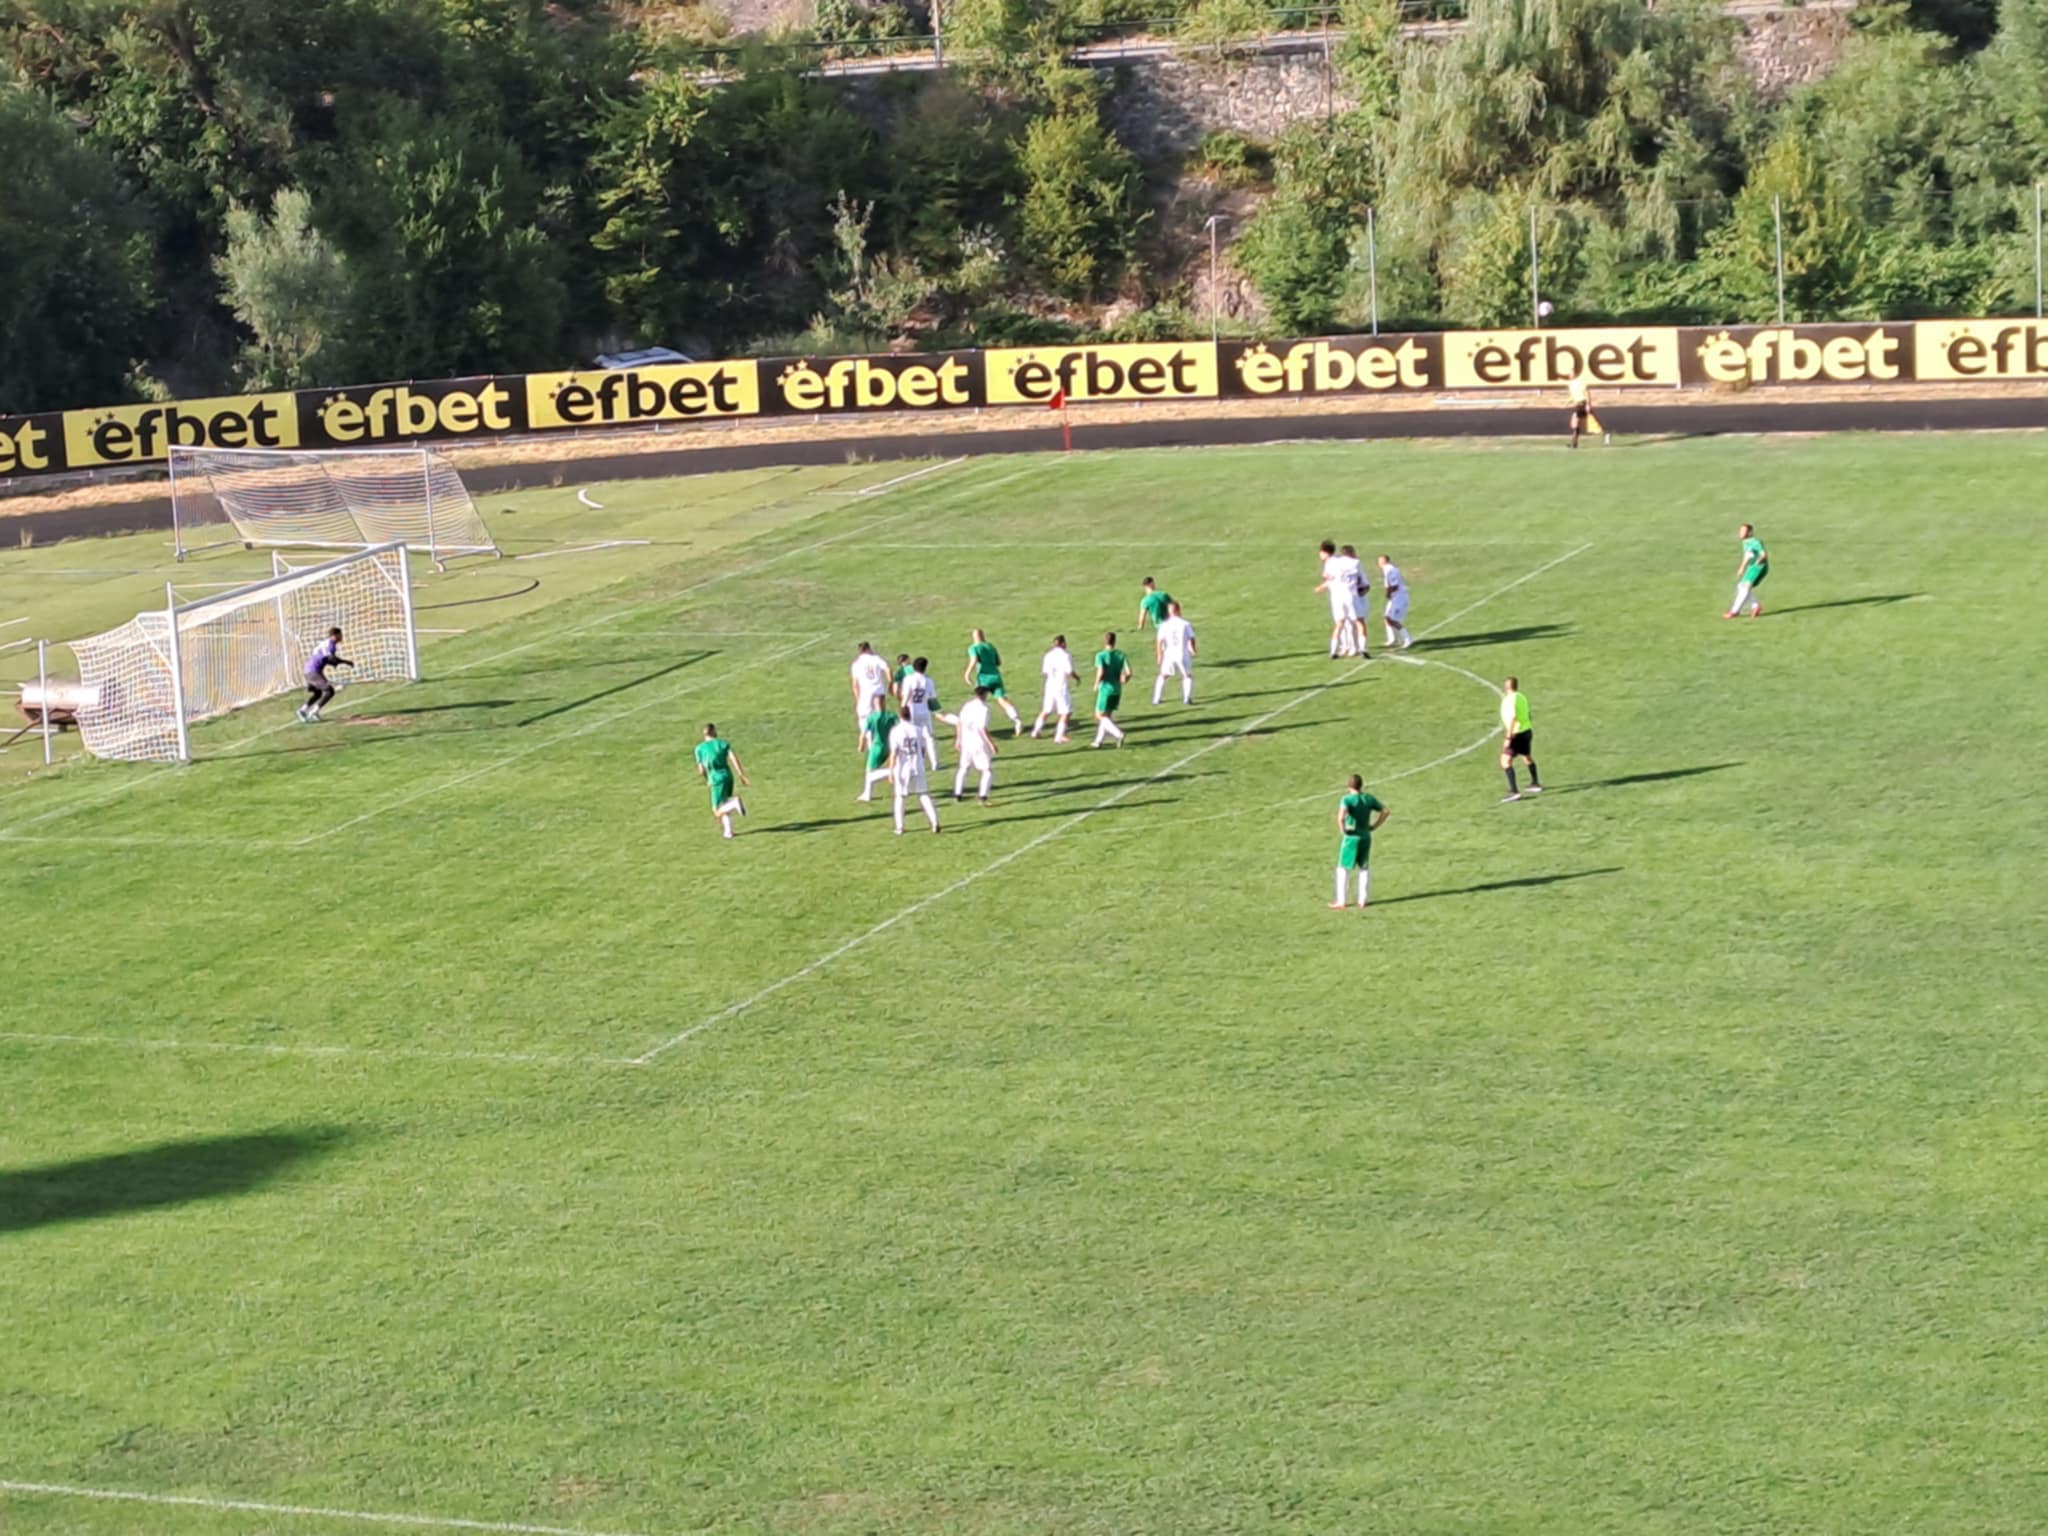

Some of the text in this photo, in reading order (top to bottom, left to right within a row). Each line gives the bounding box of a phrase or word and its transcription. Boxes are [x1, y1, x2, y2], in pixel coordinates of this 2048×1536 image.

[1014, 349, 1197, 398] efbet
[1241, 338, 1428, 393] efbet
[1473, 335, 1657, 383] efbet
[1703, 327, 1899, 381] efbet
[555, 367, 739, 422] efbet
[783, 356, 969, 410] efbet
[93, 400, 279, 460] efbet
[323, 382, 511, 441] efbet
